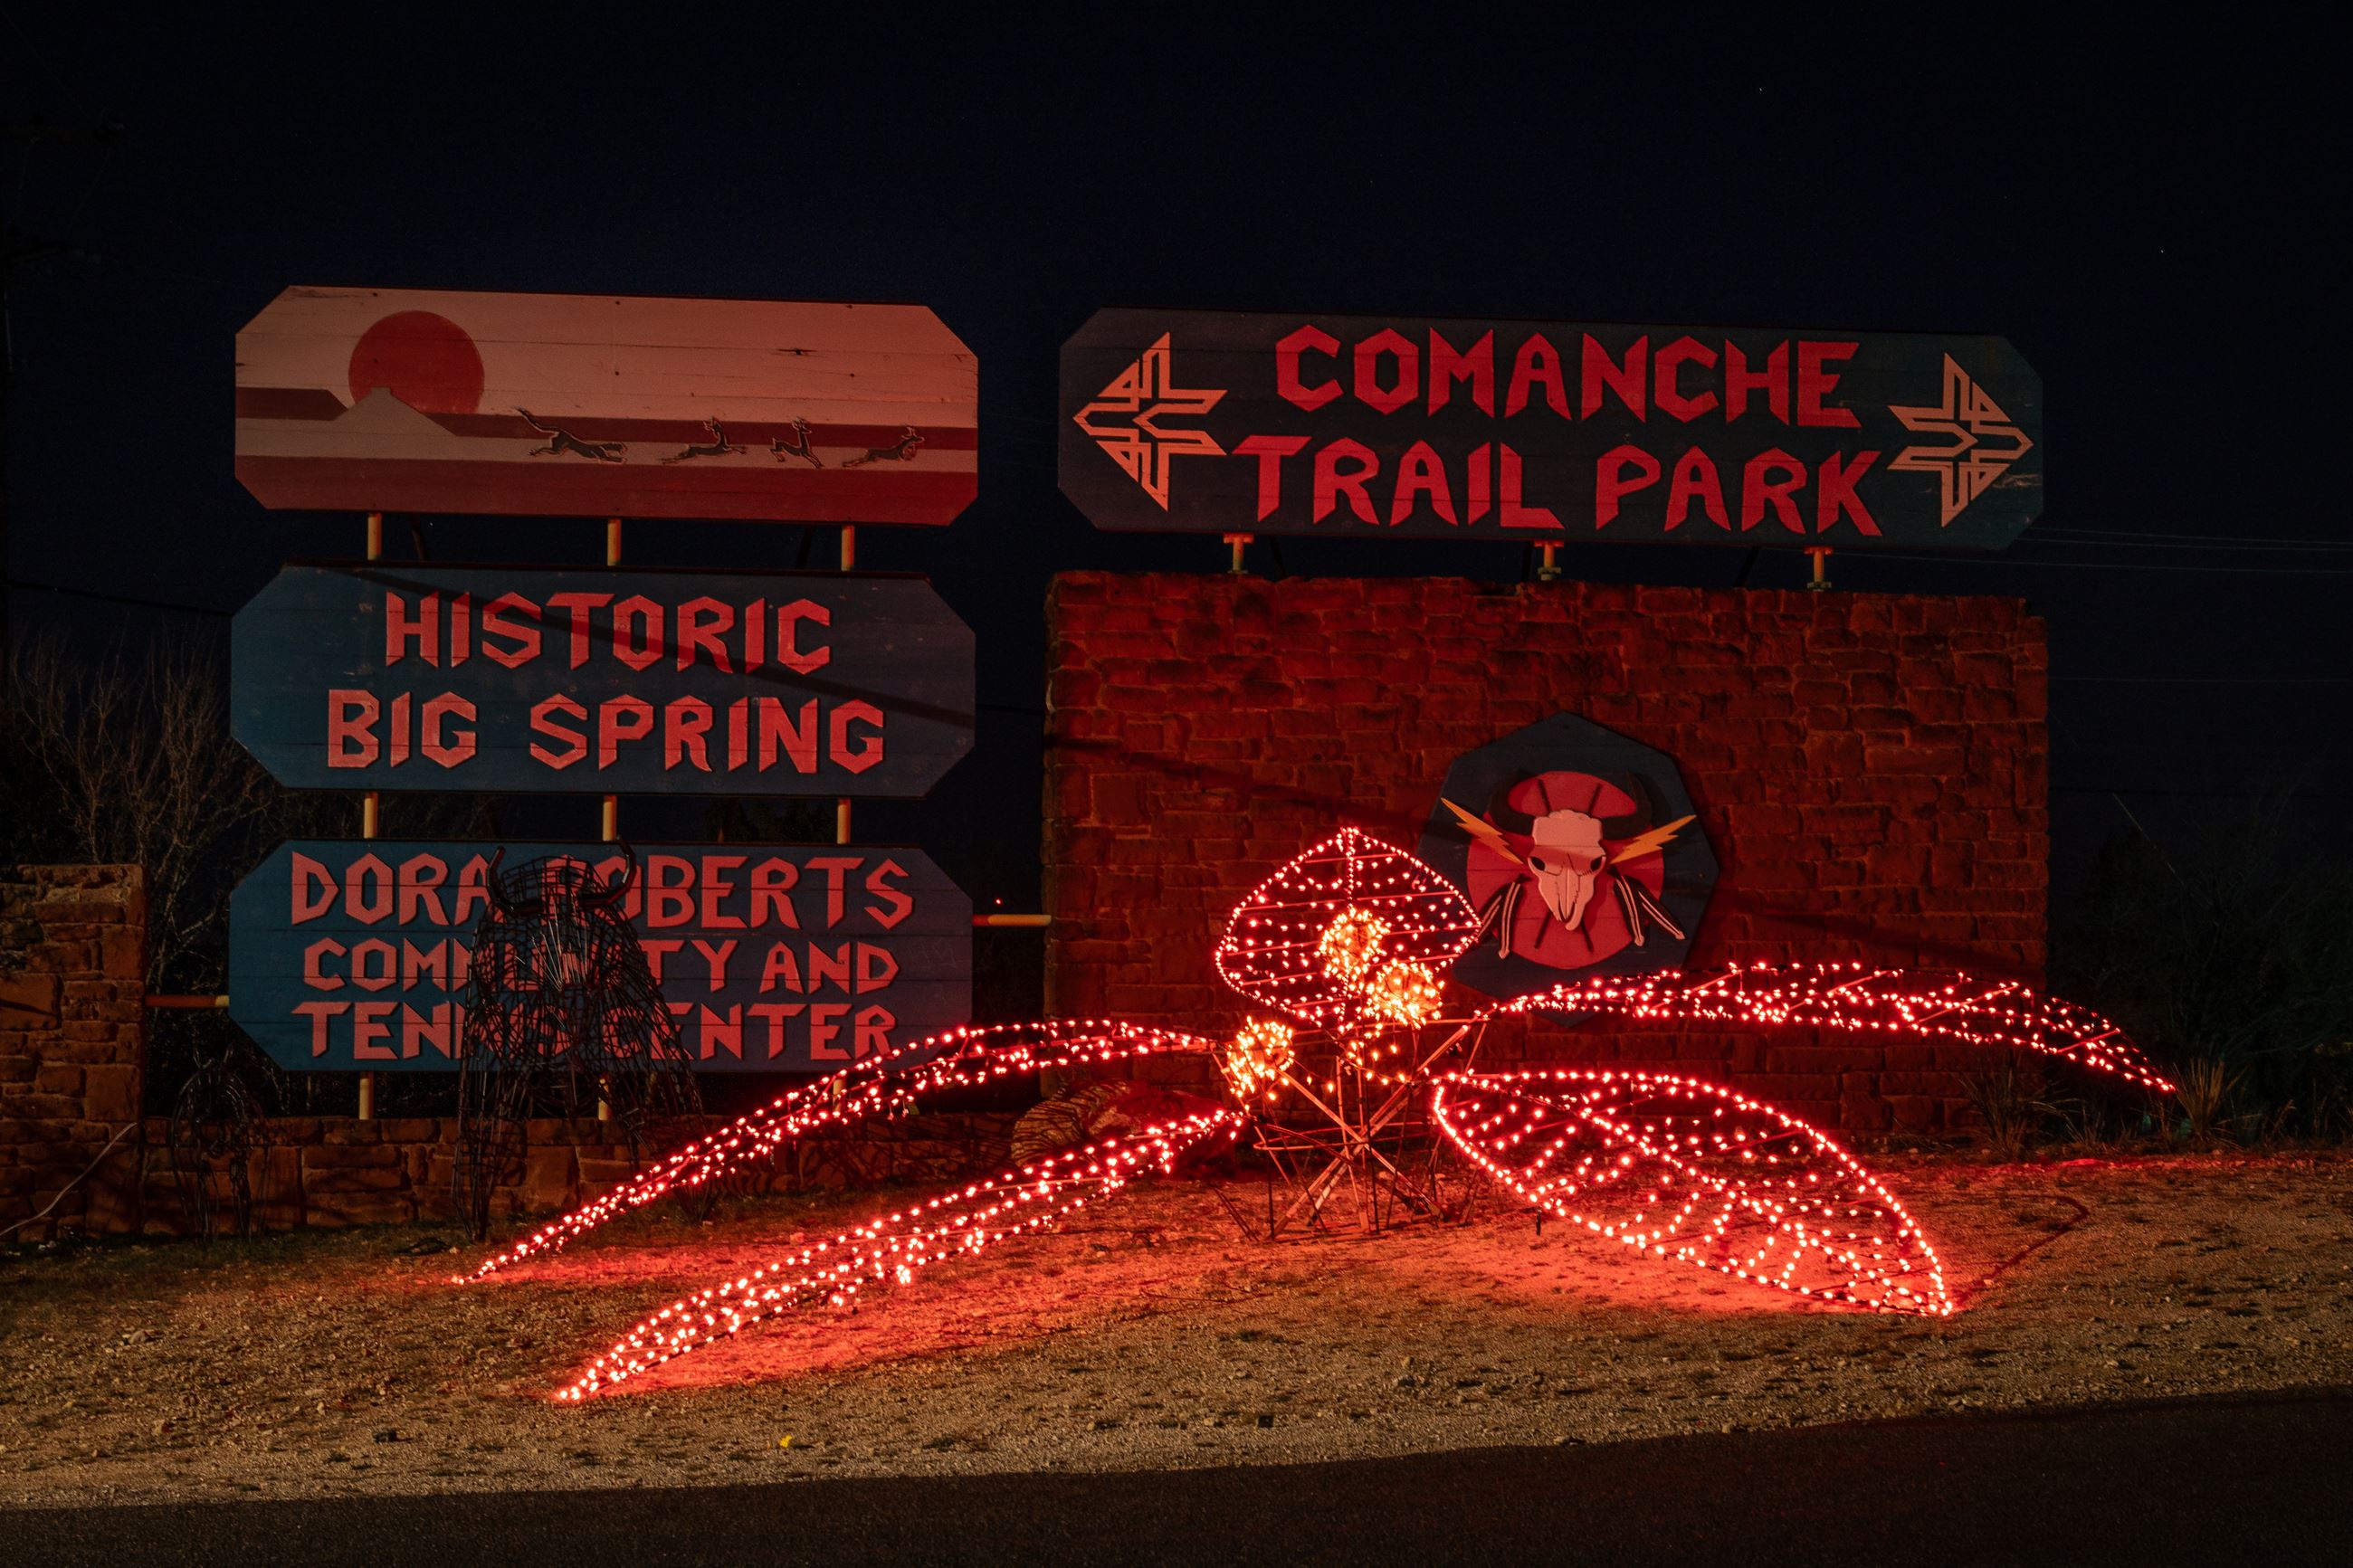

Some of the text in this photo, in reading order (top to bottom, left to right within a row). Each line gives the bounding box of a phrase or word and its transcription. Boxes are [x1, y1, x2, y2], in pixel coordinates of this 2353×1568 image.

[1275, 325, 1862, 428] COMANCHE
[1232, 435, 1882, 537] TRAIL PARK
[386, 591, 831, 675] HISTORIC
[328, 689, 886, 774] BIG SPRING
[291, 851, 508, 927] DORA
[762, 941, 900, 996] AND
